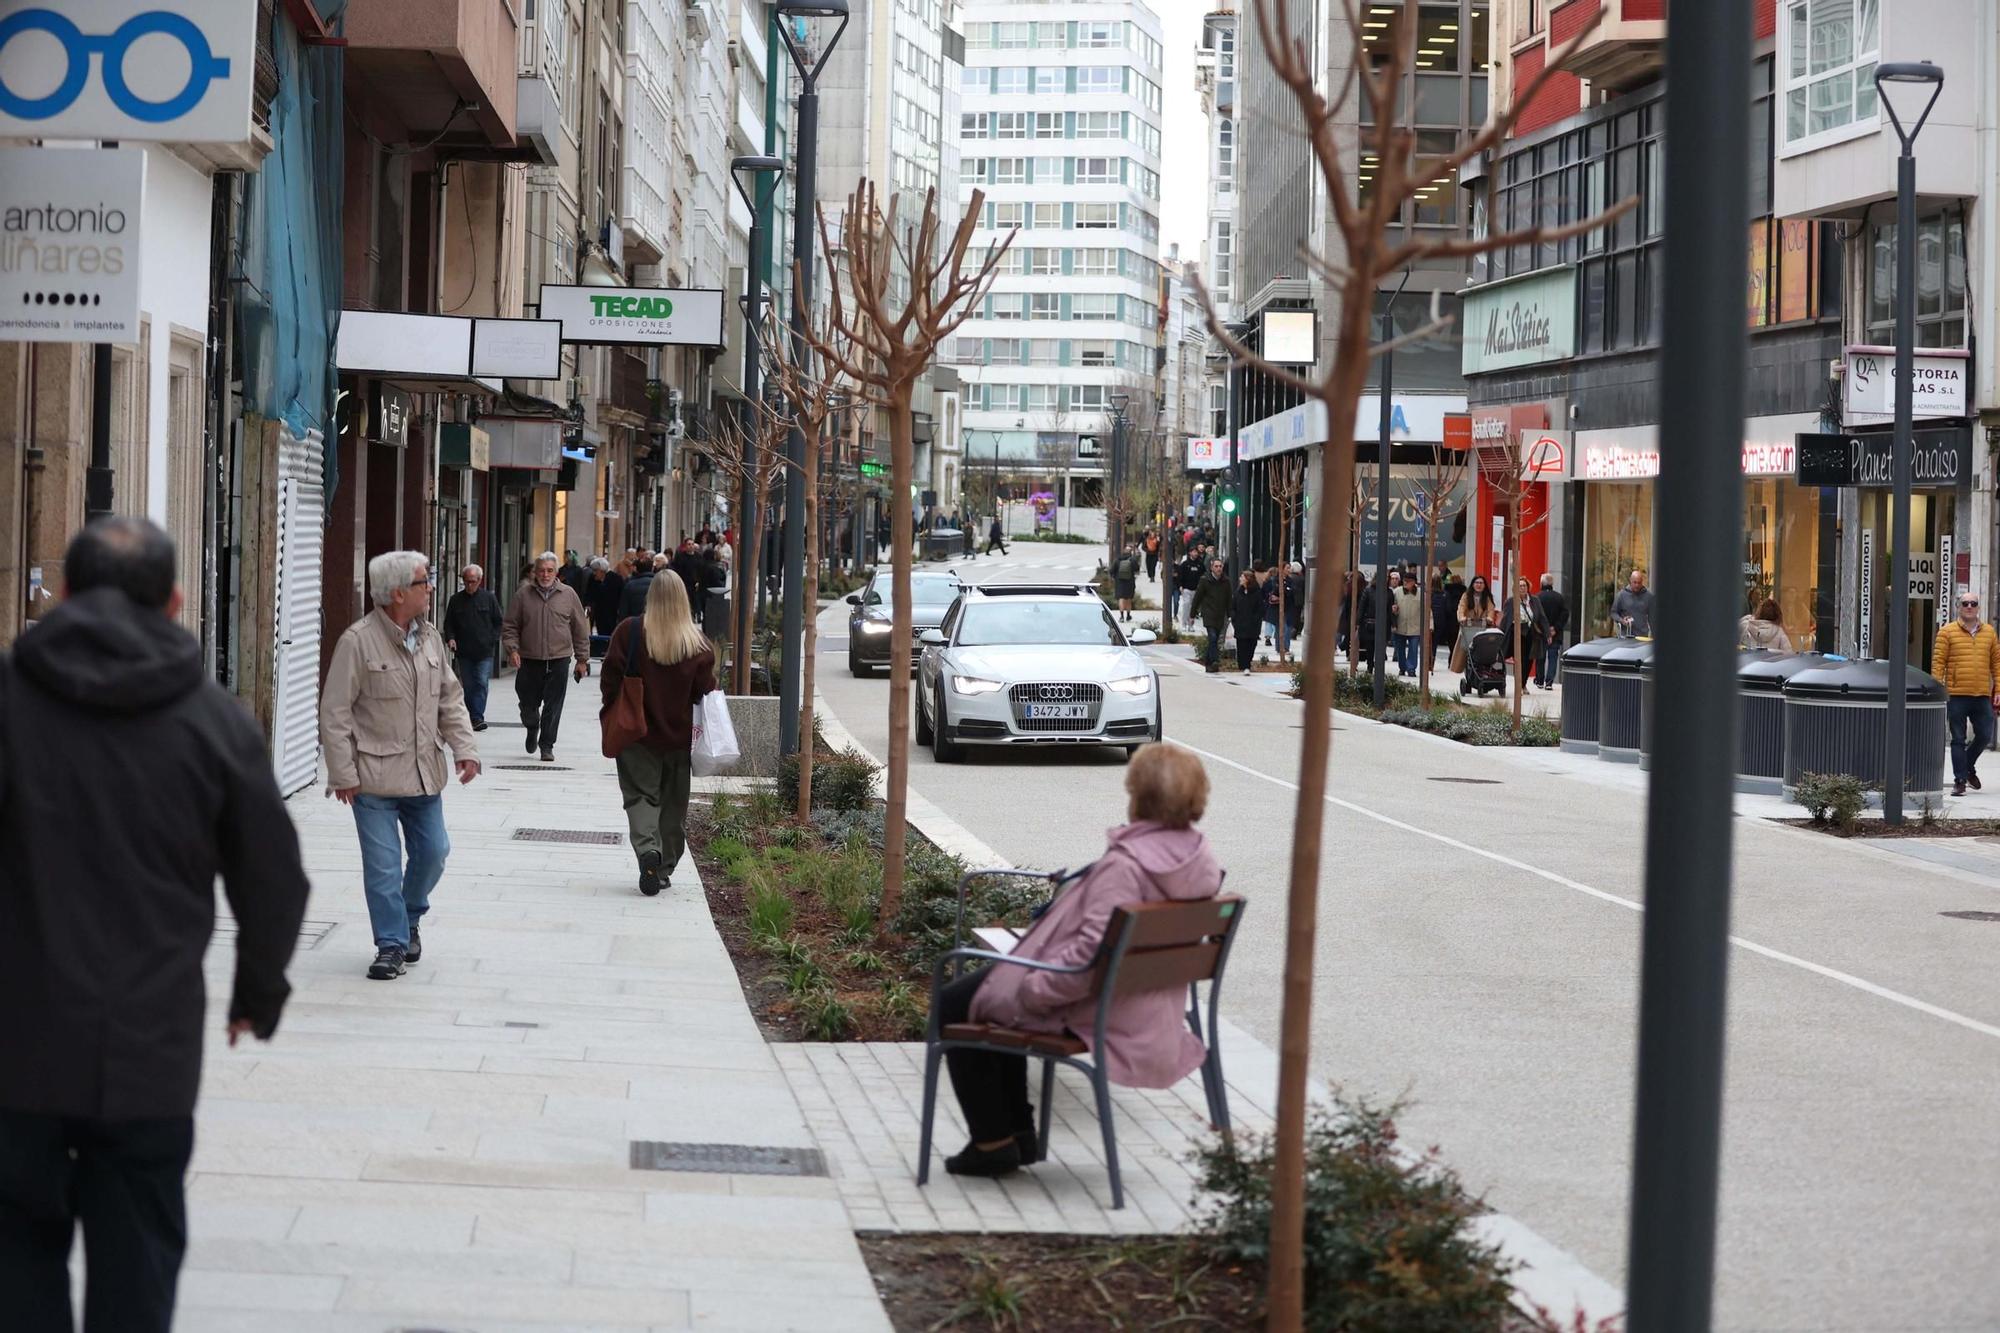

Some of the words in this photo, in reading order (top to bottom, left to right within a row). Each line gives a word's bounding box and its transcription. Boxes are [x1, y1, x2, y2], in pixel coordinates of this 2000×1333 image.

[4, 202, 126, 234] antonio
[1, 235, 125, 274] liñares
[590, 295, 673, 319] TECAD
[73, 320, 125, 331] implantes
[590, 319, 672, 328] OPOSICIONES
[1891, 368, 1959, 381] GSTORIA
[1850, 439, 1894, 482] Planet
[1909, 580, 1934, 595] POR
[1033, 706, 1061, 717] 3472
[1065, 706, 1085, 717] JWY
